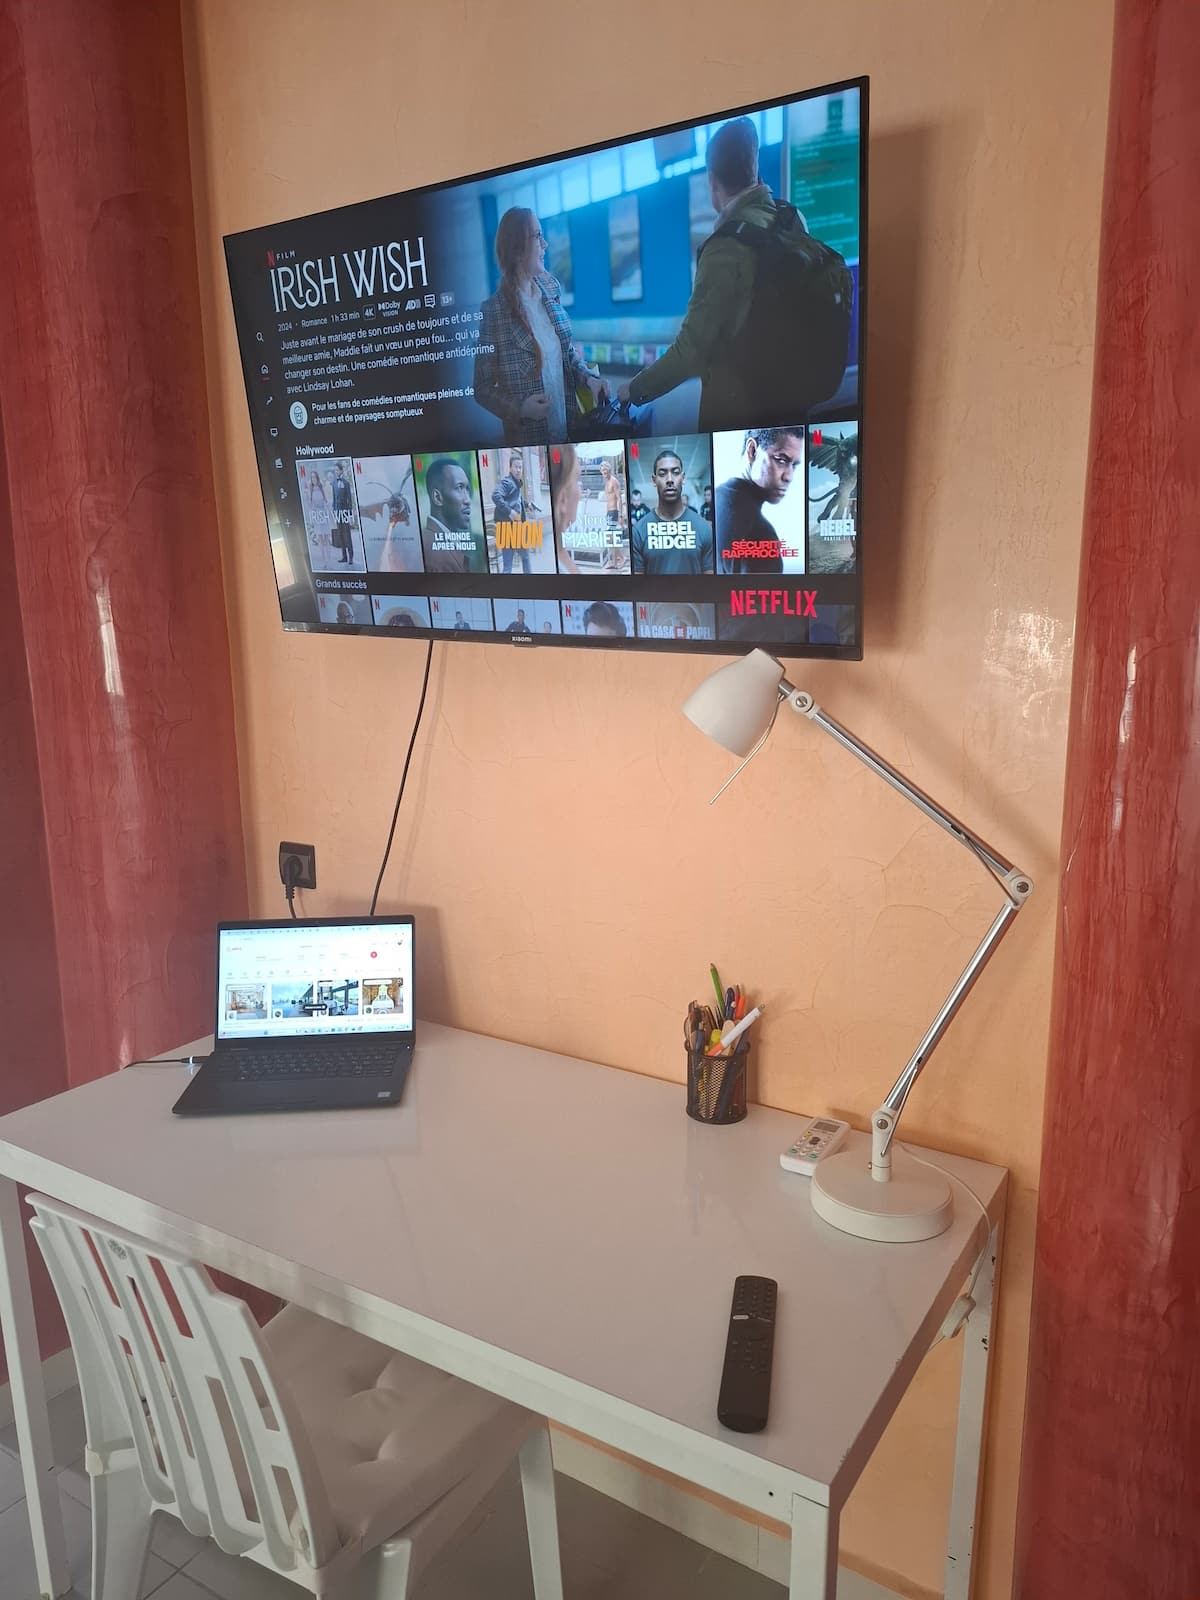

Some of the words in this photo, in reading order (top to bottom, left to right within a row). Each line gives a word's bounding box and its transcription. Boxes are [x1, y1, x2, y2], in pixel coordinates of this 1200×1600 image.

[276, 250, 296, 260] FILM
[270, 255, 341, 313] IRISH
[343, 236, 429, 299] WISH
[277, 322, 293, 332] 2024
[302, 317, 328, 328] Romance
[340, 312, 348, 321] 33
[349, 311, 360, 320] min
[364, 308, 374, 317] 4K
[281, 340, 300, 350] Juste
[300, 336, 319, 347] avant
[320, 335, 327, 344] le
[328, 331, 356, 343] mariage
[357, 328, 368, 339] de
[368, 328, 381, 337] son
[383, 323, 404, 335] crush
[406, 321, 416, 331] de
[417, 316, 450, 330] toujours
[451, 314, 460, 322] et
[461, 312, 472, 322] de
[472, 312, 484, 320] sa
[282, 353, 313, 365] meilleure
[314, 350, 332, 360] amie,
[334, 346, 360, 358] Maddie
[361, 344, 373, 354] fait
[374, 343, 384, 352] un
[386, 340, 403, 350] vœu
[404, 339, 414, 348] un
[415, 337, 430, 349] peu
[455, 330, 468, 342] qui
[469, 329, 480, 339] va
[284, 368, 312, 380] changer
[312, 366, 326, 376] son
[326, 364, 350, 374] destin.
[351, 360, 366, 371] Une
[367, 356, 399, 368] comédie
[400, 351, 444, 365] romantique
[446, 344, 495, 359] antidéprime
[286, 384, 302, 394] avec
[303, 381, 329, 392] Lindsay
[330, 378, 355, 388] Lohan.
[312, 402, 326, 411] Pour
[327, 401, 337, 410] les
[338, 400, 351, 409] fans
[352, 398, 361, 407] de
[361, 395, 393, 406] comédies
[394, 390, 437, 403] romantiques
[438, 388, 464, 400] pleines
[464, 386, 474, 396] de
[314, 415, 337, 425] charme
[337, 414, 344, 423] et
[345, 413, 354, 422] de
[354, 411, 385, 422] paysages
[386, 408, 424, 420] somptueux
[296, 444, 335, 456] Hollywood
[330, 510, 354, 524] WISH
[496, 520, 543, 549] UNION
[647, 520, 696, 536] REBEL
[434, 532, 444, 541] LE
[444, 532, 471, 541] MONDE
[648, 536, 696, 550] RIDGE
[456, 542, 476, 550] NOUS
[315, 579, 341, 589] Grands
[342, 580, 368, 589] succès
[730, 590, 818, 618] NETFLIX
[652, 625, 674, 639] CASA
[686, 626, 713, 640] PAPEL
